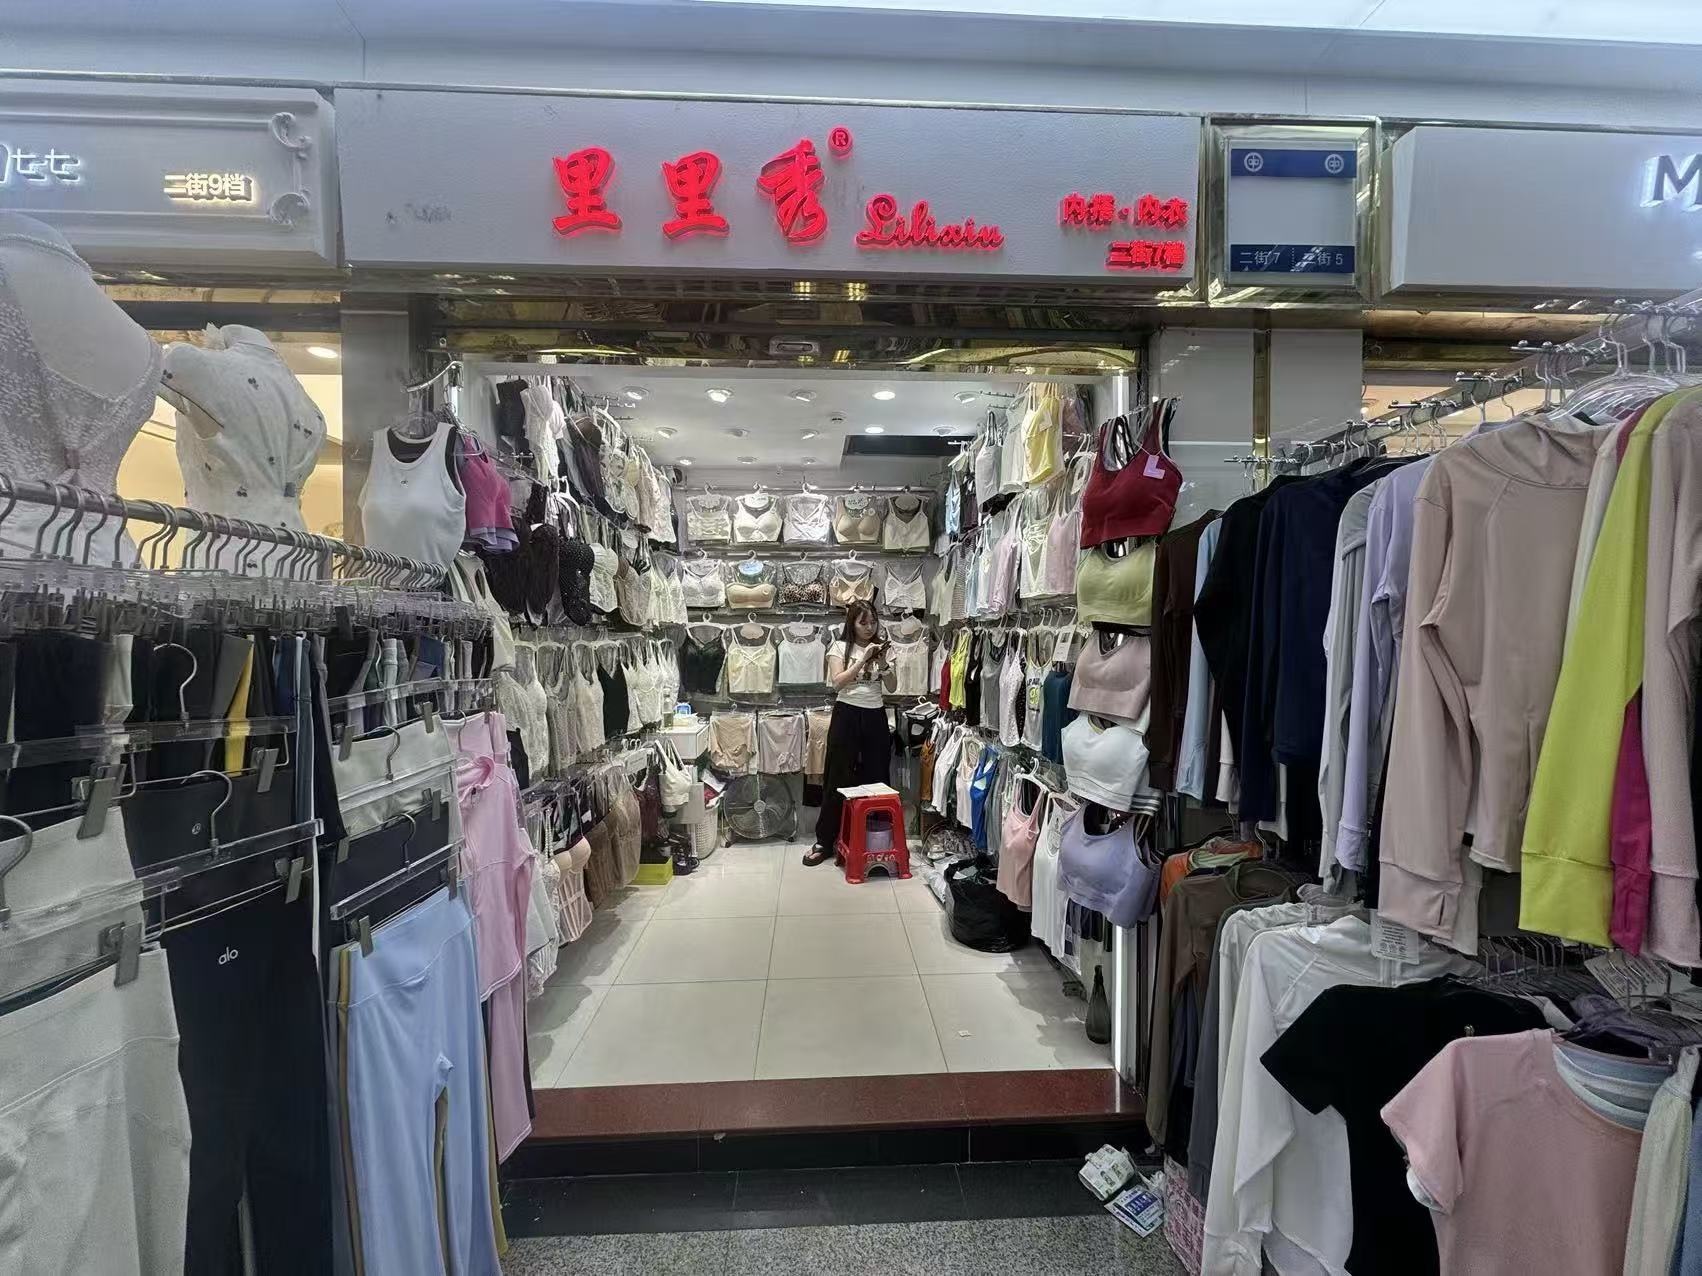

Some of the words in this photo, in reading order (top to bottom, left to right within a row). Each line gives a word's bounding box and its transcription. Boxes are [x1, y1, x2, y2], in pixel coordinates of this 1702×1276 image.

[163, 172, 251, 199] 二街9档
[553, 139, 828, 243] 里里秀
[855, 193, 1004, 250] Lilixiu
[218, 946, 239, 965] alo
